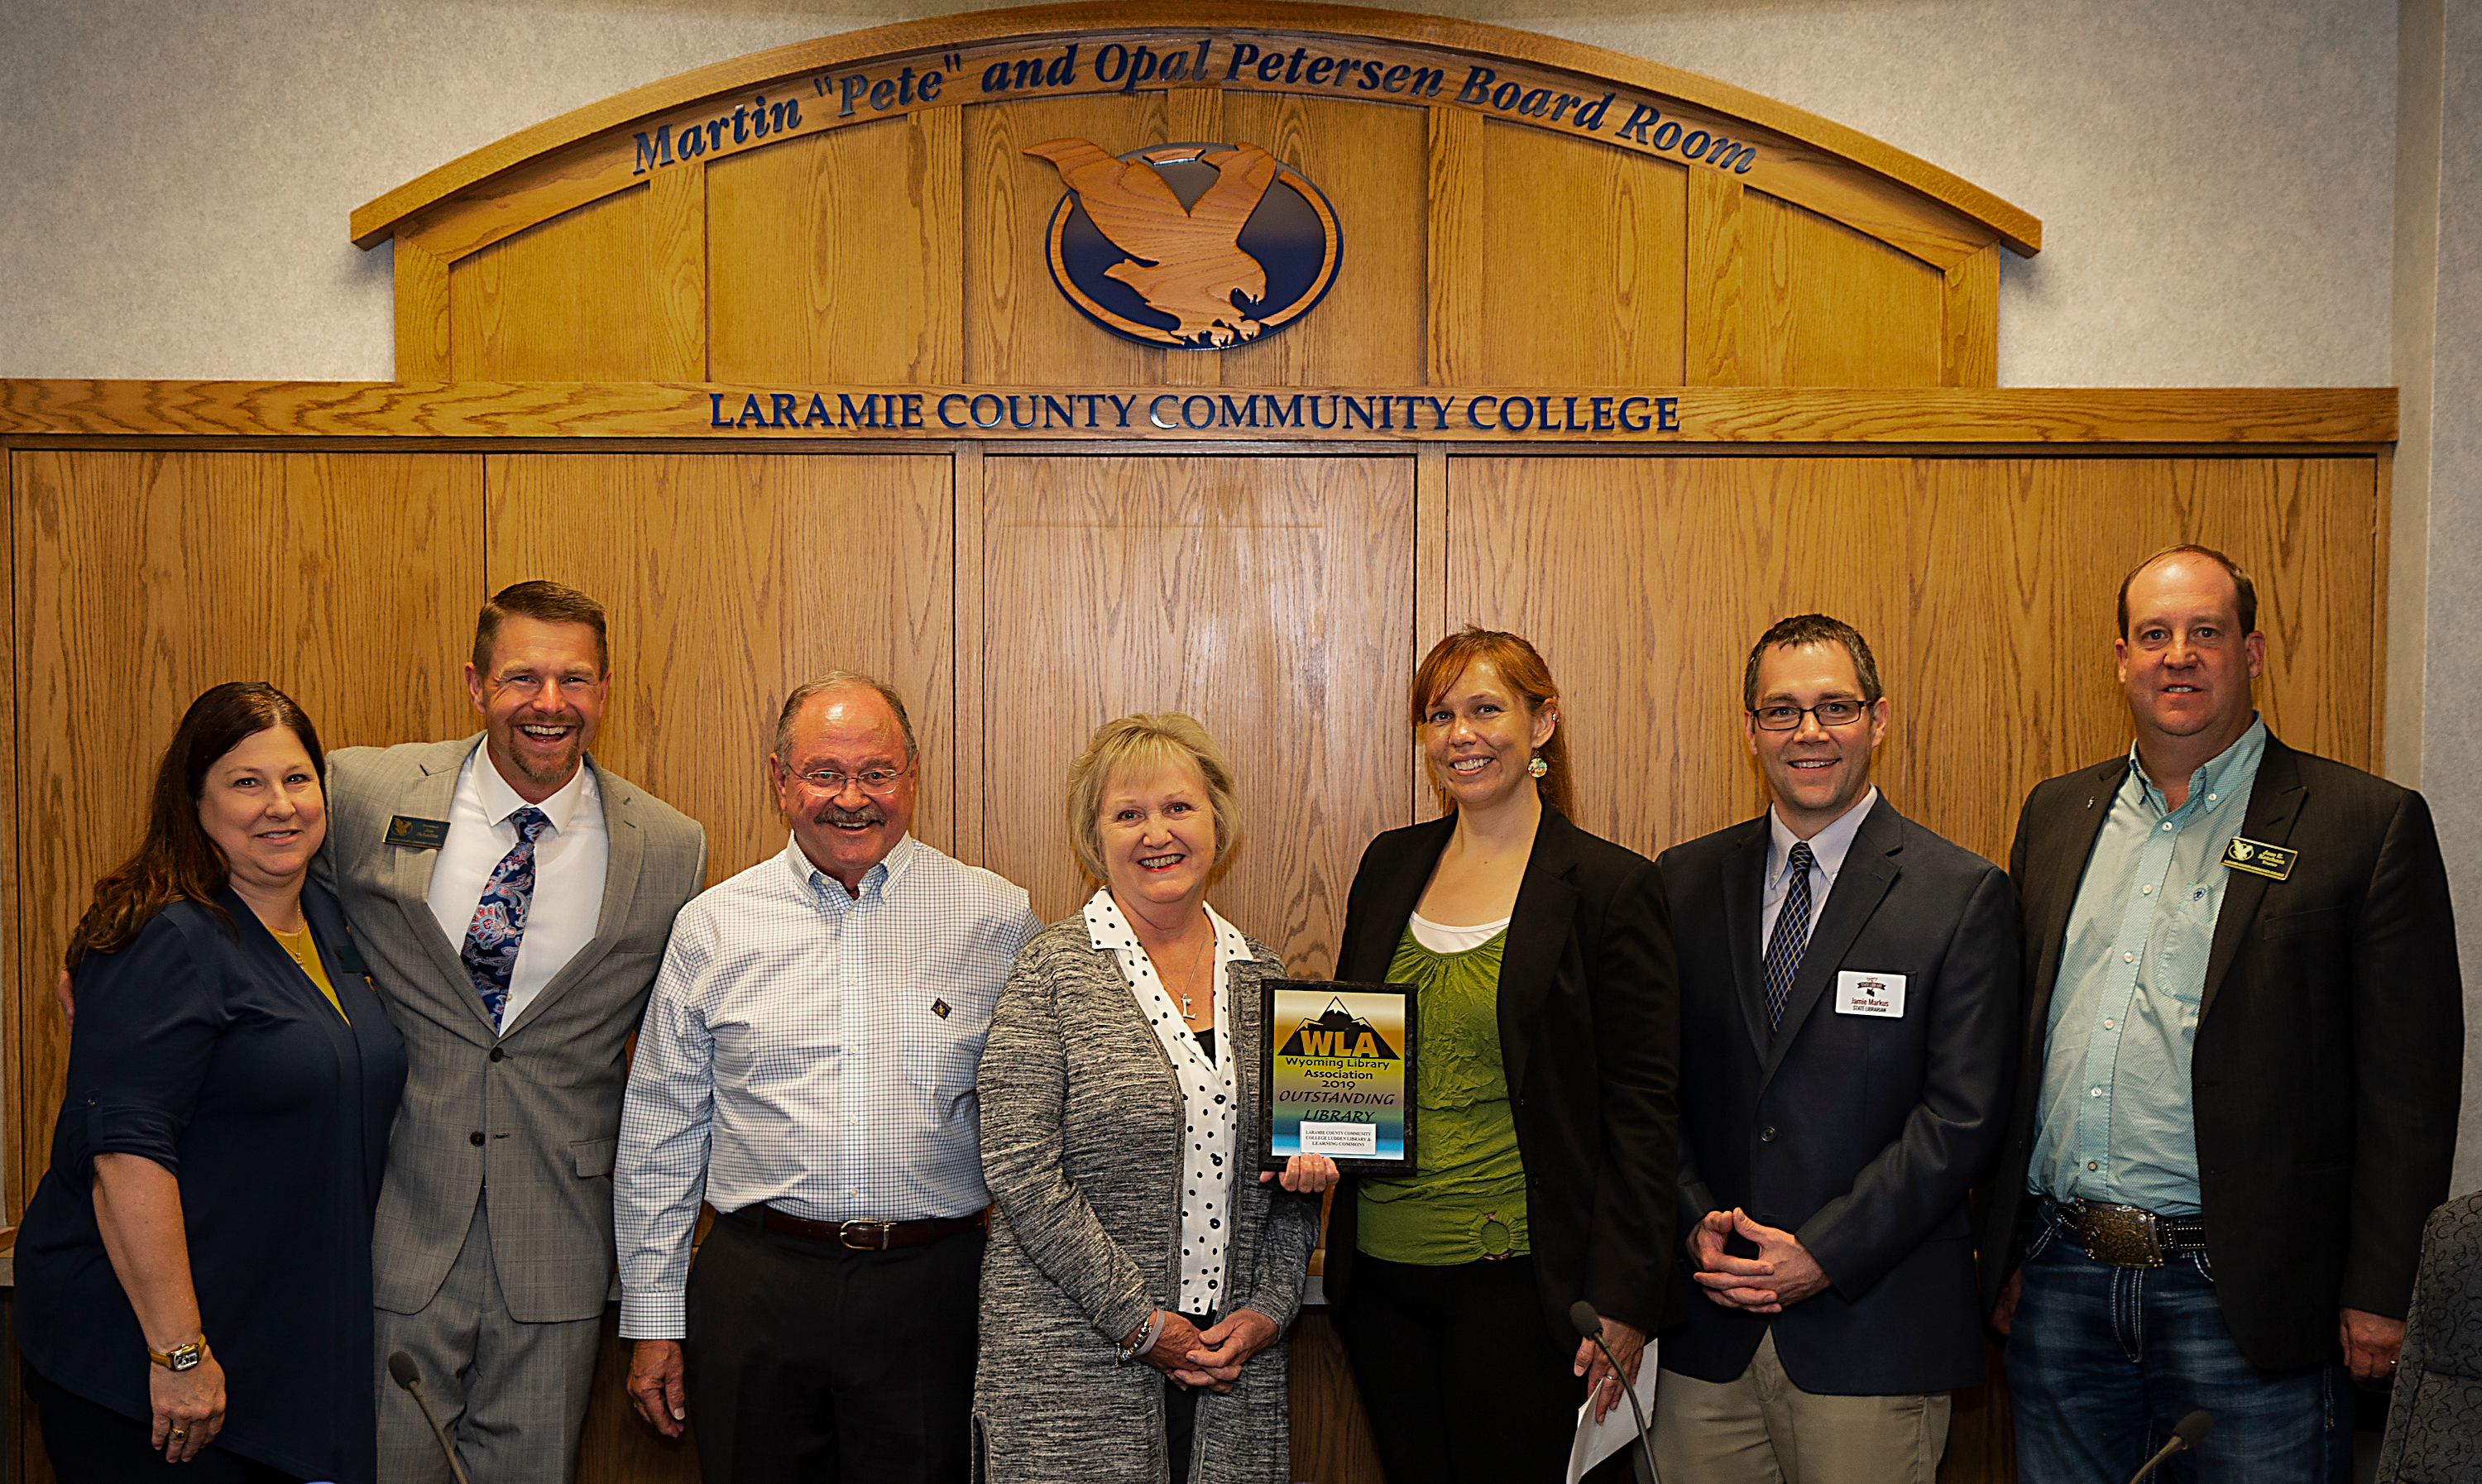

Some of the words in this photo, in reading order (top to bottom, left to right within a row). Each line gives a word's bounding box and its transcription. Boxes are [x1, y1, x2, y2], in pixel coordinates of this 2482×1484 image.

[632, 95, 803, 176] Martin
[813, 53, 961, 118] "Pete"
[981, 42, 1079, 94] and
[1094, 39, 1210, 94] Opal
[1223, 43, 1445, 98] Petersen
[1453, 65, 1617, 131] Board
[1615, 100, 1758, 175] Room
[709, 393, 924, 428] LARAMIE
[937, 393, 1137, 429] COUNTY
[1149, 394, 1454, 430] COMMUNITY
[1467, 395, 1680, 431] COLLEGE
[1851, 997, 1867, 1005] Jamie
[1868, 998, 1889, 1007] Markus
[1300, 1031, 1380, 1057] WLA
[1286, 1057, 1344, 1068] Wyoming
[1347, 1059, 1390, 1070] Library
[1304, 1070, 1373, 1079] Association
[1321, 1080, 1356, 1090] 2019
[1279, 1090, 1395, 1105] OUTSTANDING
[1303, 1109, 1375, 1123] LIBRARY
